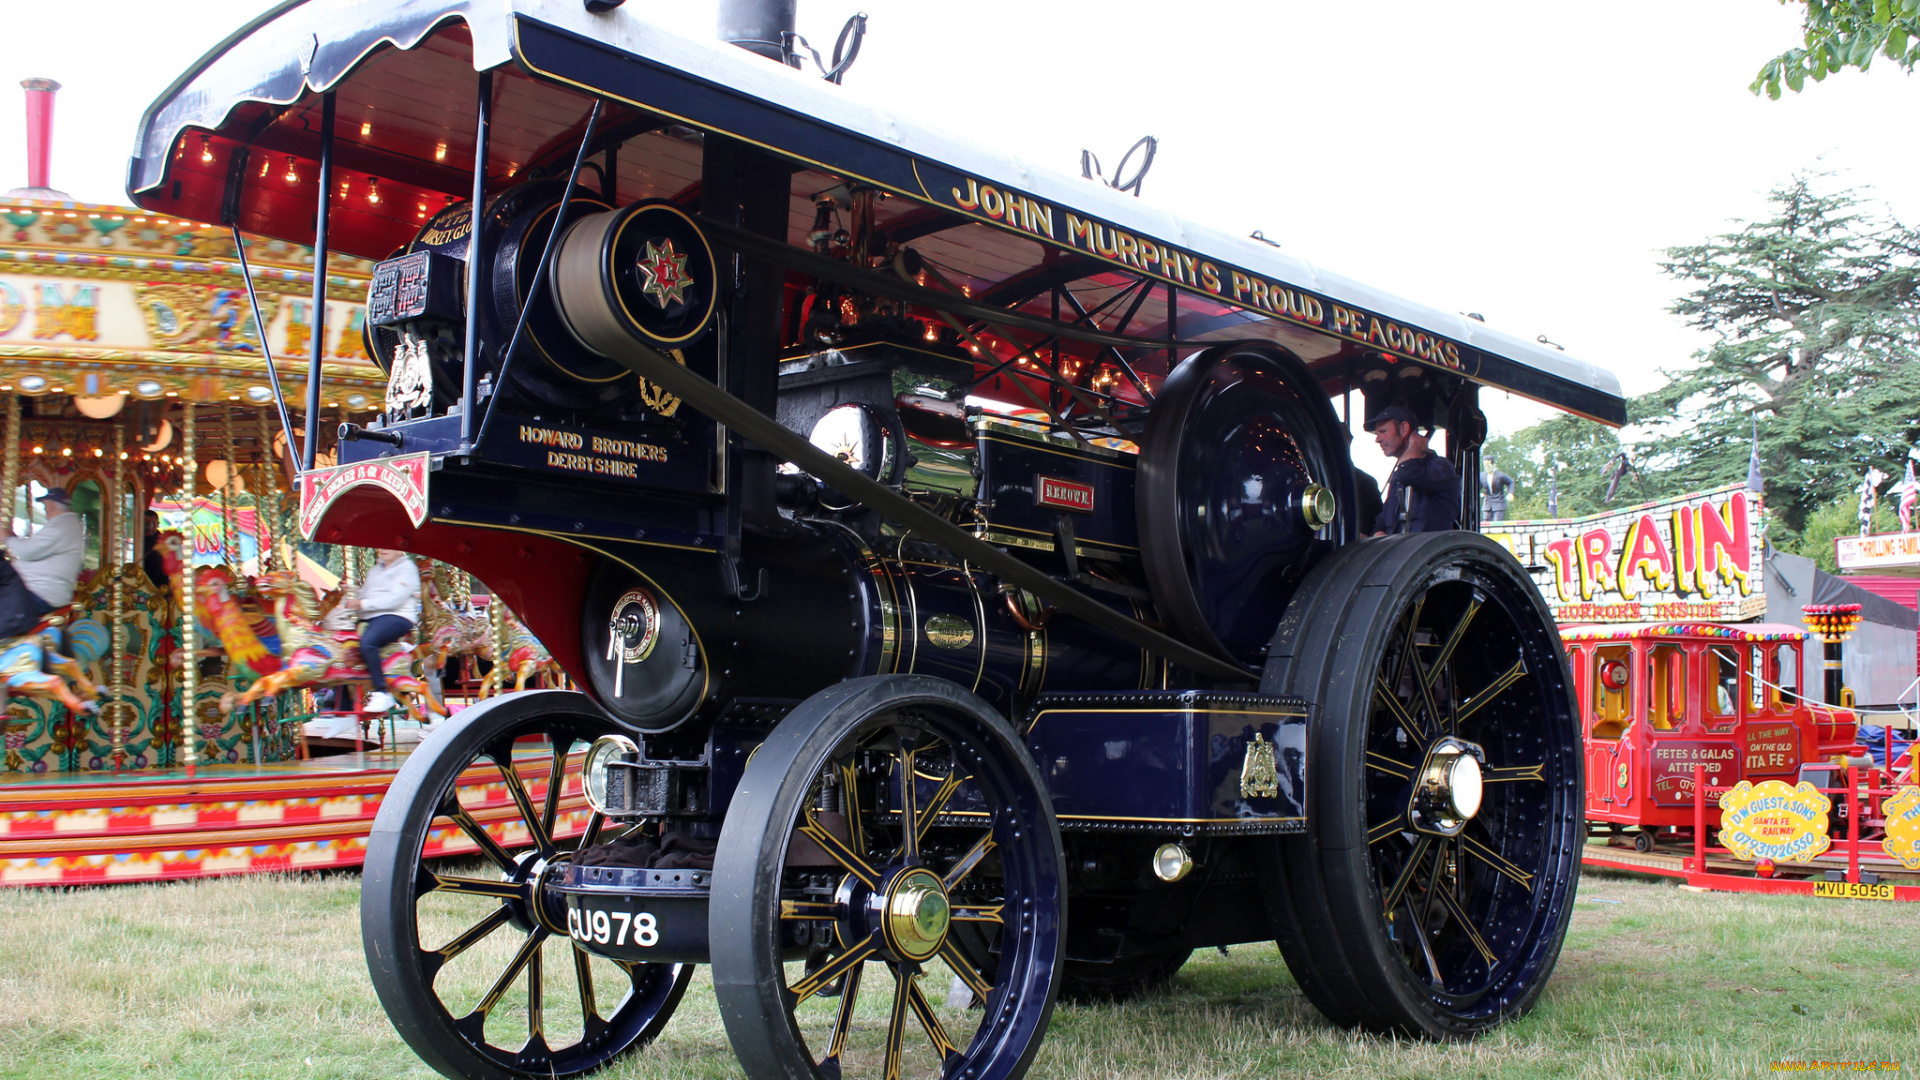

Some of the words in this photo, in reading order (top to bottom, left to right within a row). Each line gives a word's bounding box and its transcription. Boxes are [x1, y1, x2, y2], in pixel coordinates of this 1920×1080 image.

[664, 263, 676, 281] R
[952, 178, 1055, 240] JOHN
[1066, 212, 1222, 294] MURPHYS
[1231, 270, 1324, 325] PROUD
[1332, 303, 1466, 371] PEACOCKS.
[519, 425, 583, 450] HOWARD
[592, 436, 668, 463] BROTHERS
[547, 451, 638, 479] DERBYSHIRE
[1045, 483, 1090, 505] RENOWN
[1544, 492, 1752, 602] TRAIN
[1858, 539, 1895, 558] THRILLING
[1558, 604, 1641, 620] HORRORS
[1656, 603, 1722, 619] INSIDE
[1758, 730, 1773, 740] THE
[1774, 727, 1790, 737] WAY
[1656, 749, 1688, 759] FETES
[1691, 749, 1699, 759] &
[1700, 749, 1734, 759] GALAS
[1761, 743, 1776, 752] THE
[1776, 743, 1792, 752] OLD
[1668, 762, 1722, 773] ATTEDED
[1769, 753, 1785, 767] FE
[1617, 762, 1629, 788] 3
[1730, 814, 1742, 825] D
[1739, 806, 1750, 819] W
[1749, 797, 1784, 814] GUEST
[1783, 801, 1790, 810] &
[1789, 800, 1817, 821] SONS
[1753, 817, 1779, 826] SANTA
[1780, 817, 1790, 826] FE
[1761, 827, 1796, 837] RAILWAY
[1732, 831, 1815, 859] 07931926550
[1816, 884, 1845, 896] MVU
[1850, 884, 1890, 898] 505G
[567, 906, 660, 947] CU978
